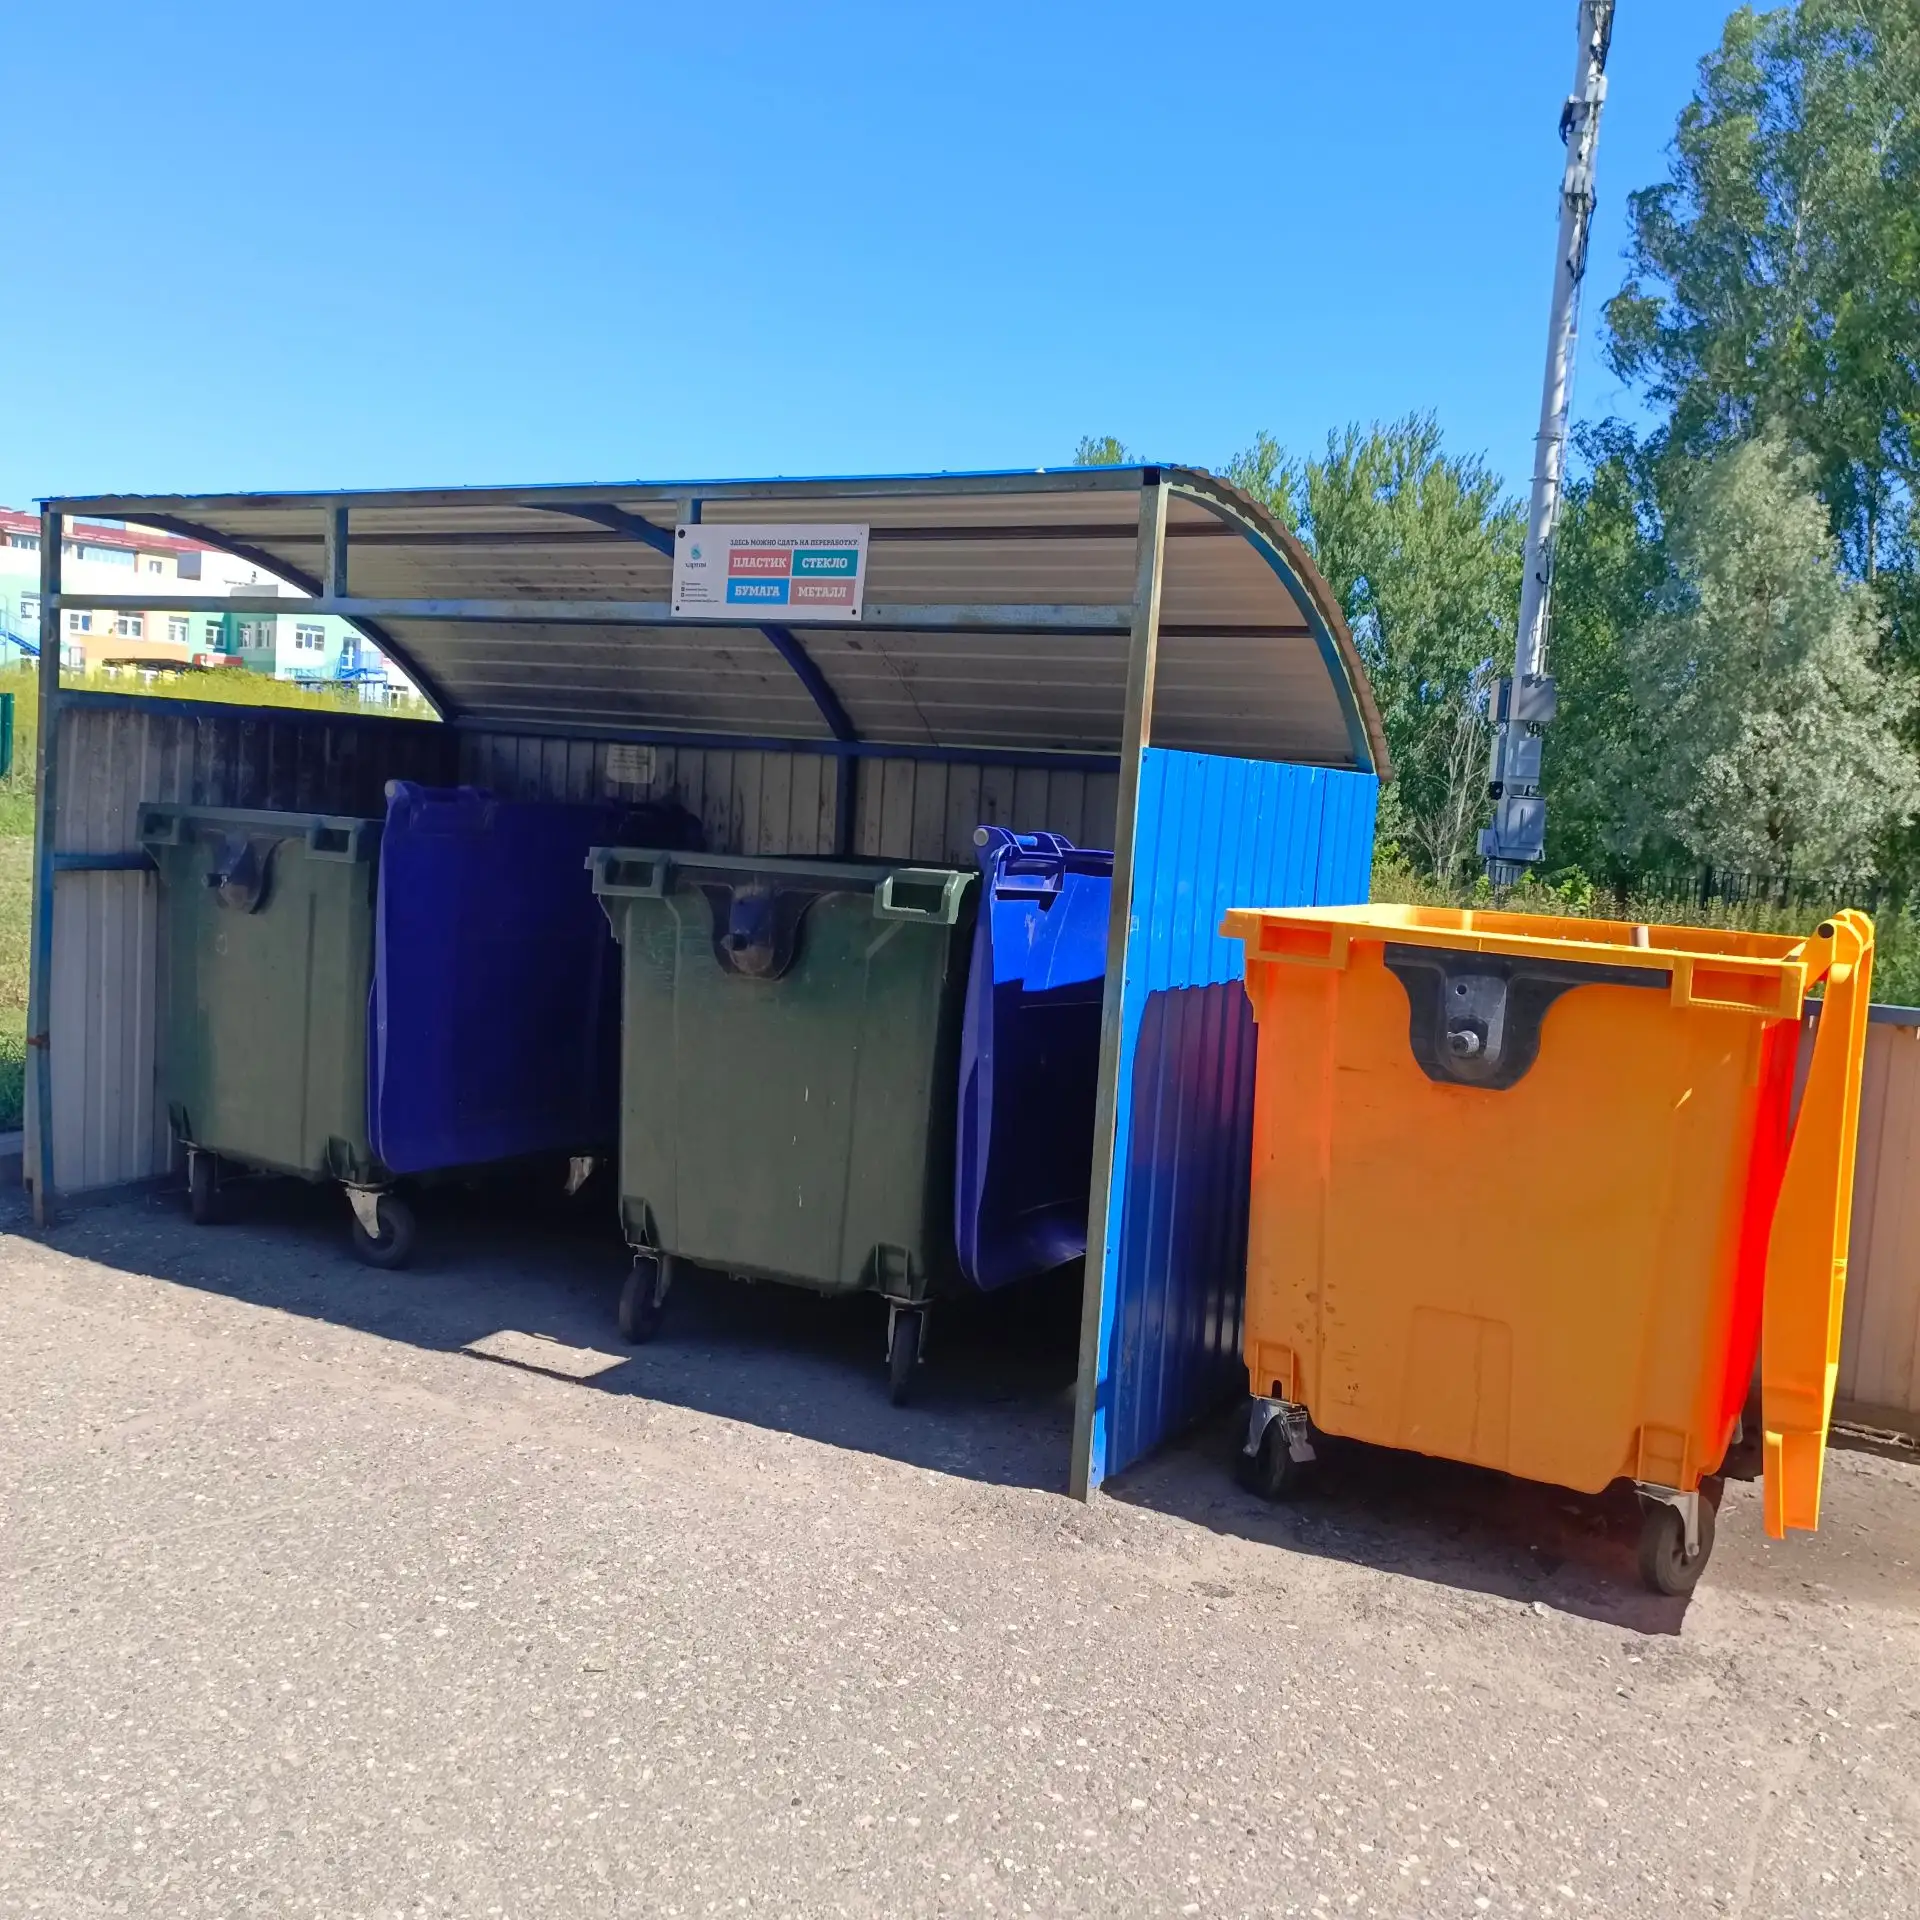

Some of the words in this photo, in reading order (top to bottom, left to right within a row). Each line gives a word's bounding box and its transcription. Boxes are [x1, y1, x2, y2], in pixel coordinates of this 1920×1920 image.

[733, 557, 787, 568] ПЛАСТИК
[801, 557, 848, 569] СТЕКЛО
[735, 586, 780, 597] БУМАГА
[798, 586, 847, 598] МЕТАЛЛ
